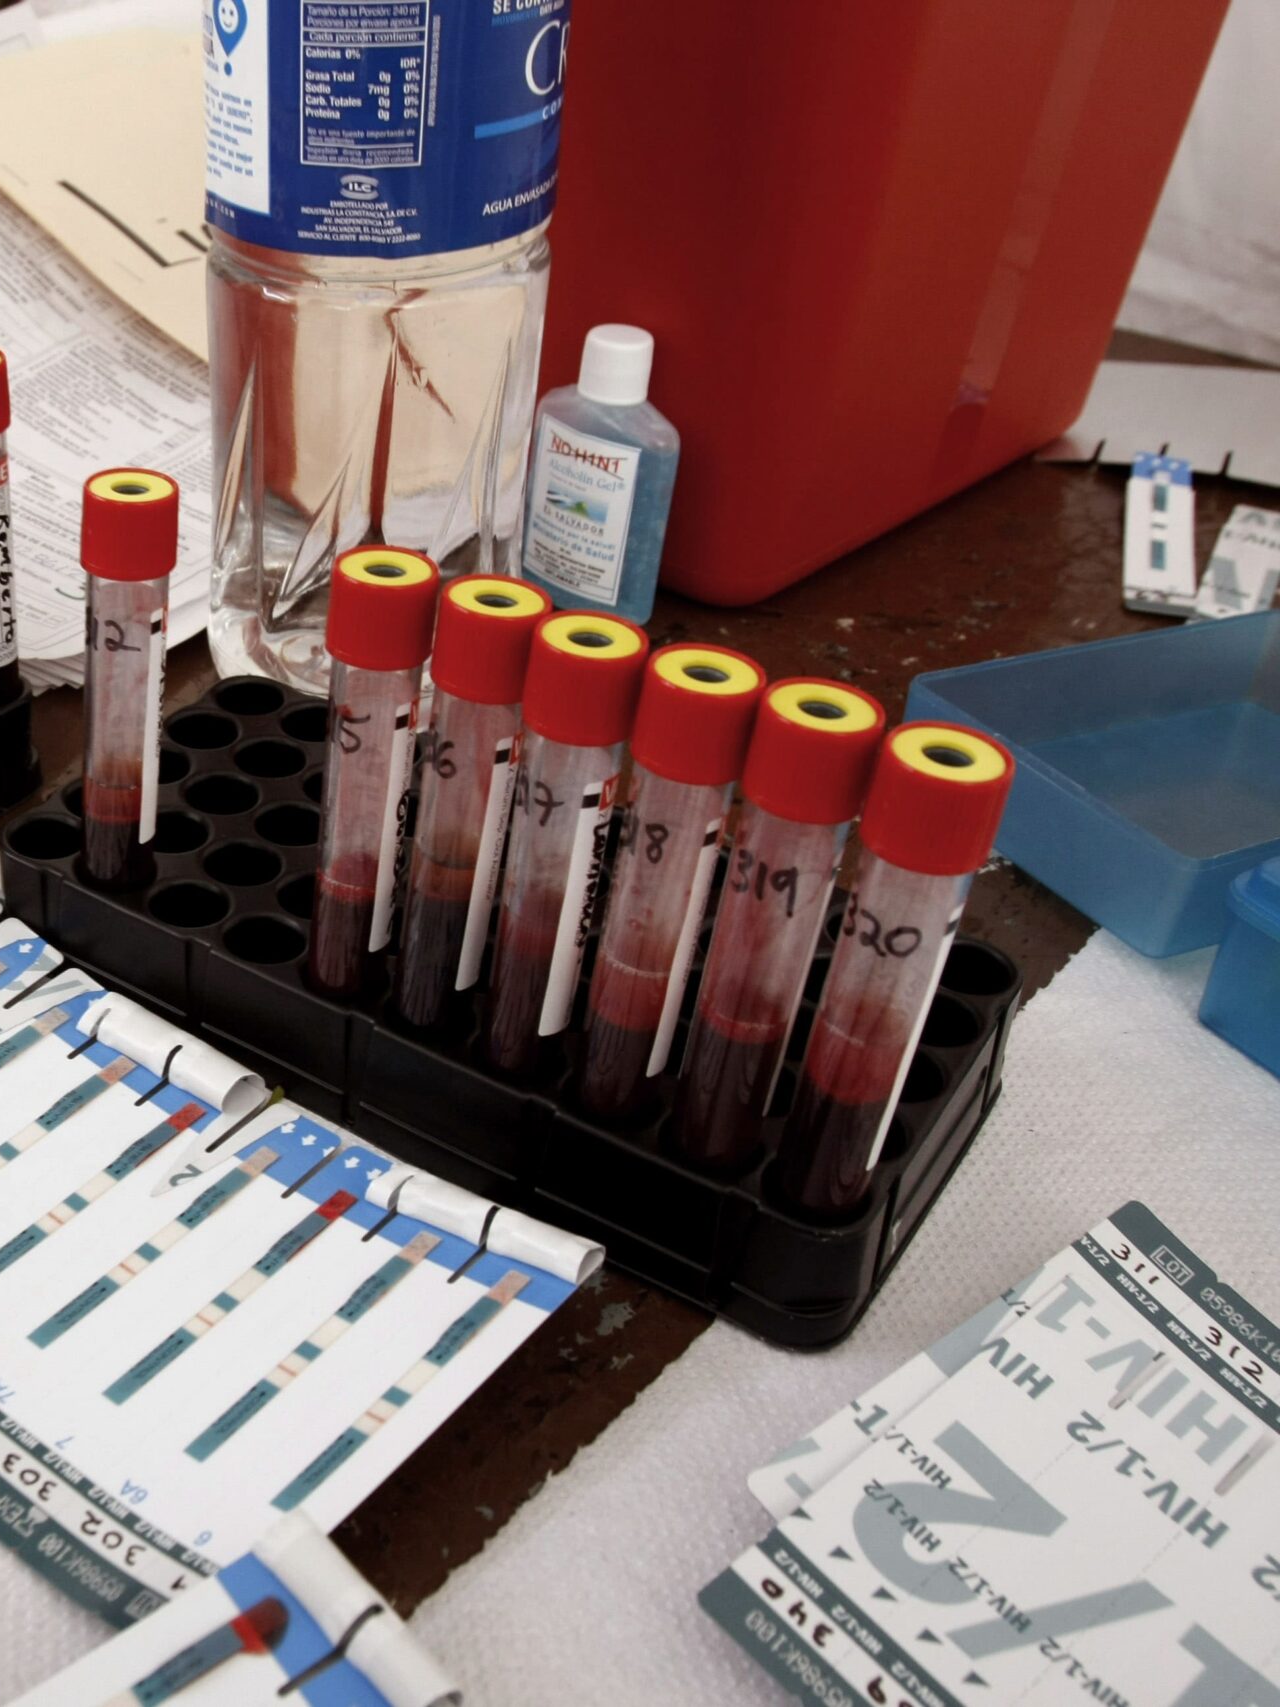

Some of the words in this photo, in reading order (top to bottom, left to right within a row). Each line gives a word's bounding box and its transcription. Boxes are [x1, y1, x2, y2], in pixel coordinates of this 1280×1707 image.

[309, 31, 332, 41] Cada
[345, 48, 360, 59] 0%
[305, 70, 330, 81] Grasa
[332, 70, 355, 82] Total
[379, 71, 391, 84] 0g
[405, 70, 420, 81] 0%
[305, 83, 331, 94] Sodio
[368, 84, 390, 97] 7mg
[403, 83, 419, 94] 0%
[330, 96, 362, 108] Totales
[378, 97, 390, 109] 0g
[404, 96, 419, 107] 0%
[378, 109, 390, 121] 0g
[403, 108, 419, 120] 0%
[482, 198, 513, 216] AGUA
[555, 511, 605, 537] SALVADOR
[1156, 1249, 1190, 1283] LOT
[1111, 1243, 1160, 1285] 311
[1204, 1325, 1265, 1384] 312
[1116, 1273, 1160, 1315] HIV-1/2
[1167, 1320, 1213, 1362] HIV-1/2
[1219, 1366, 1269, 1409] HIV-1/2
[1, 1452, 59, 1502] 303
[120, 1479, 149, 1504] 6A
[1066, 1410, 1230, 1549] HIV-1/2
[863, 1478, 942, 1553] HIV-1/2
[81, 1509, 147, 1566] 302
[773, 1548, 824, 1598] HIV-1/2
[947, 1556, 1032, 1635] HIV-1/2
[831, 1603, 883, 1655] HIV-1/2
[1039, 1636, 1131, 1707] HIV-1/2
